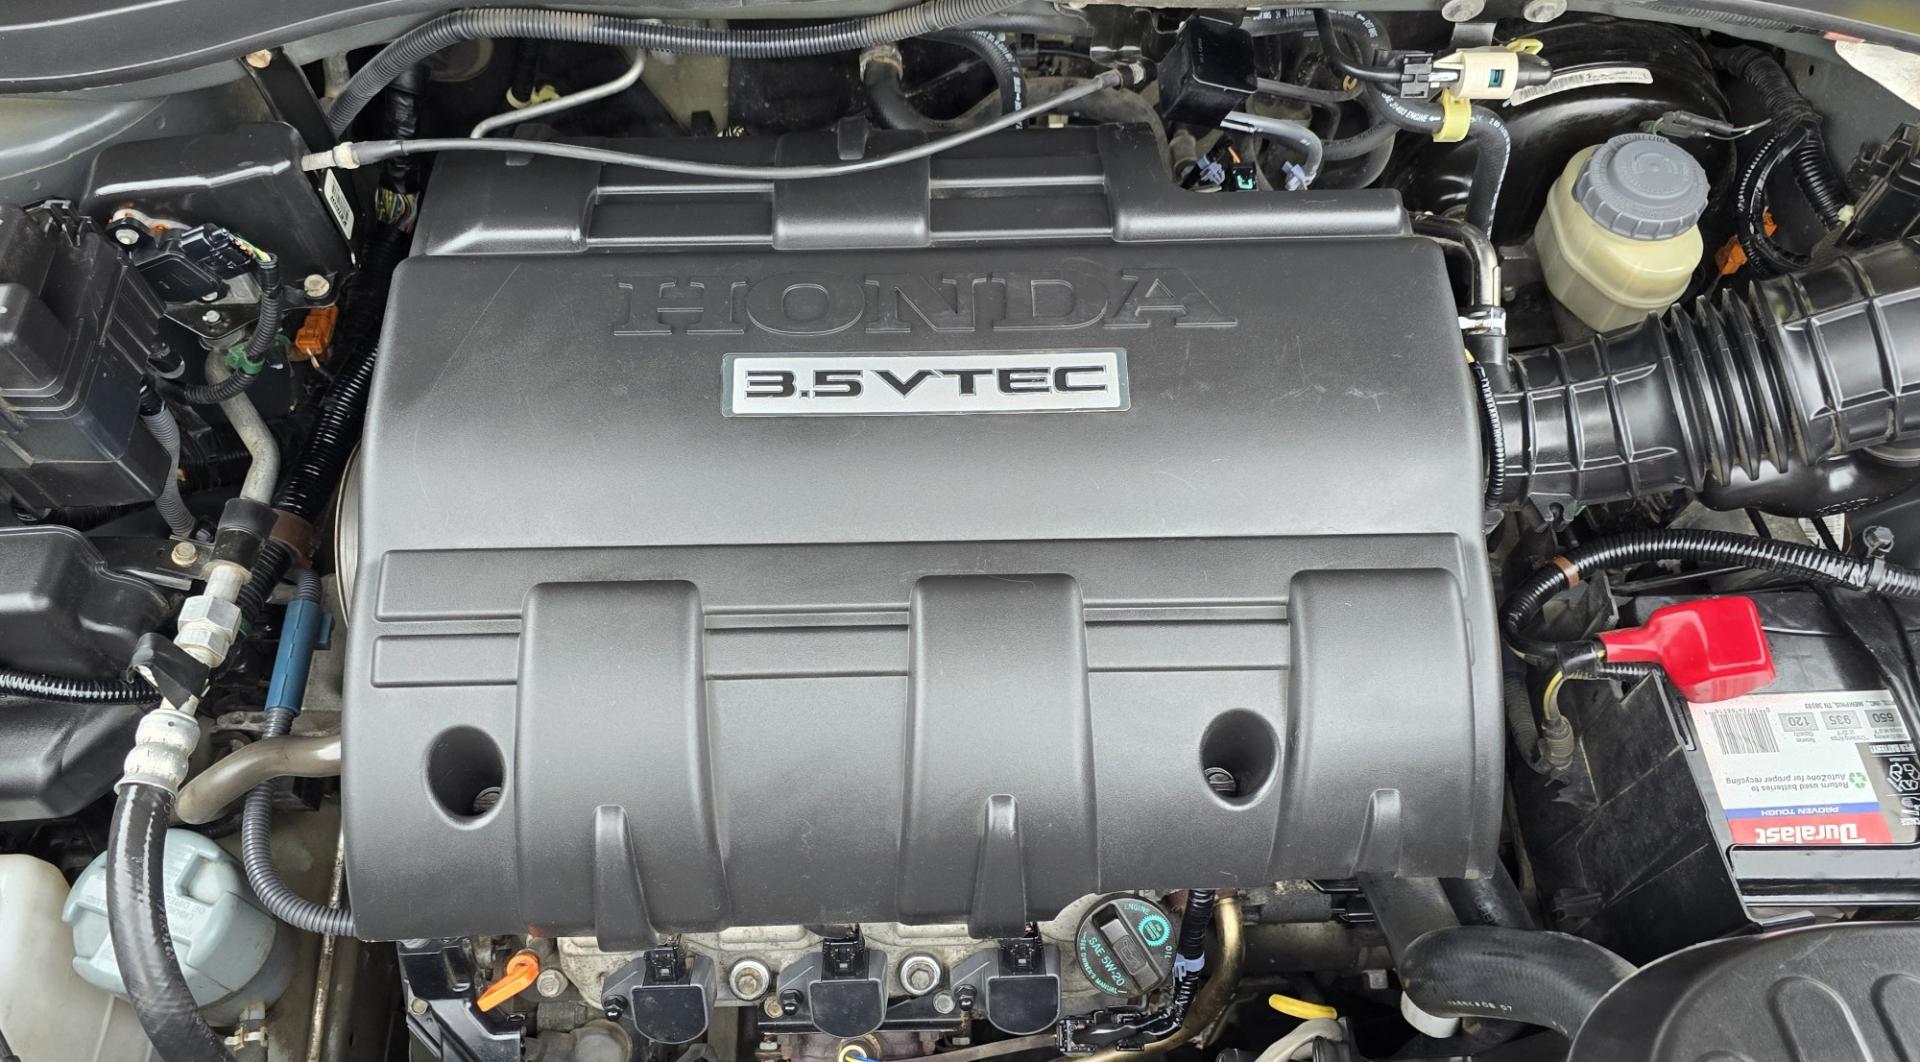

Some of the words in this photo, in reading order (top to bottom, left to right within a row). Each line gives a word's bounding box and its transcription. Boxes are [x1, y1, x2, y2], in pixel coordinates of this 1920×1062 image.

[614, 269, 1238, 337] HONDA
[744, 367, 864, 399] 3.5
[869, 365, 1108, 397] VTEC
[1788, 715, 1810, 726] 120
[1828, 714, 1851, 725] 935
[1873, 712, 1895, 723] 650
[1726, 777, 1762, 785] recycling
[1764, 774, 1791, 783] proper
[1806, 774, 1846, 782] AutoZone
[1761, 809, 1795, 817] TOUGH
[1798, 807, 1840, 815] PROVEN
[1755, 823, 1866, 844] Duralast
[1124, 903, 1151, 915] ENGINE
[1164, 945, 1173, 959] OIL
[1089, 937, 1105, 957] SAE
[1101, 955, 1125, 986] 5W-20
[1095, 978, 1118, 994] MANUAL
